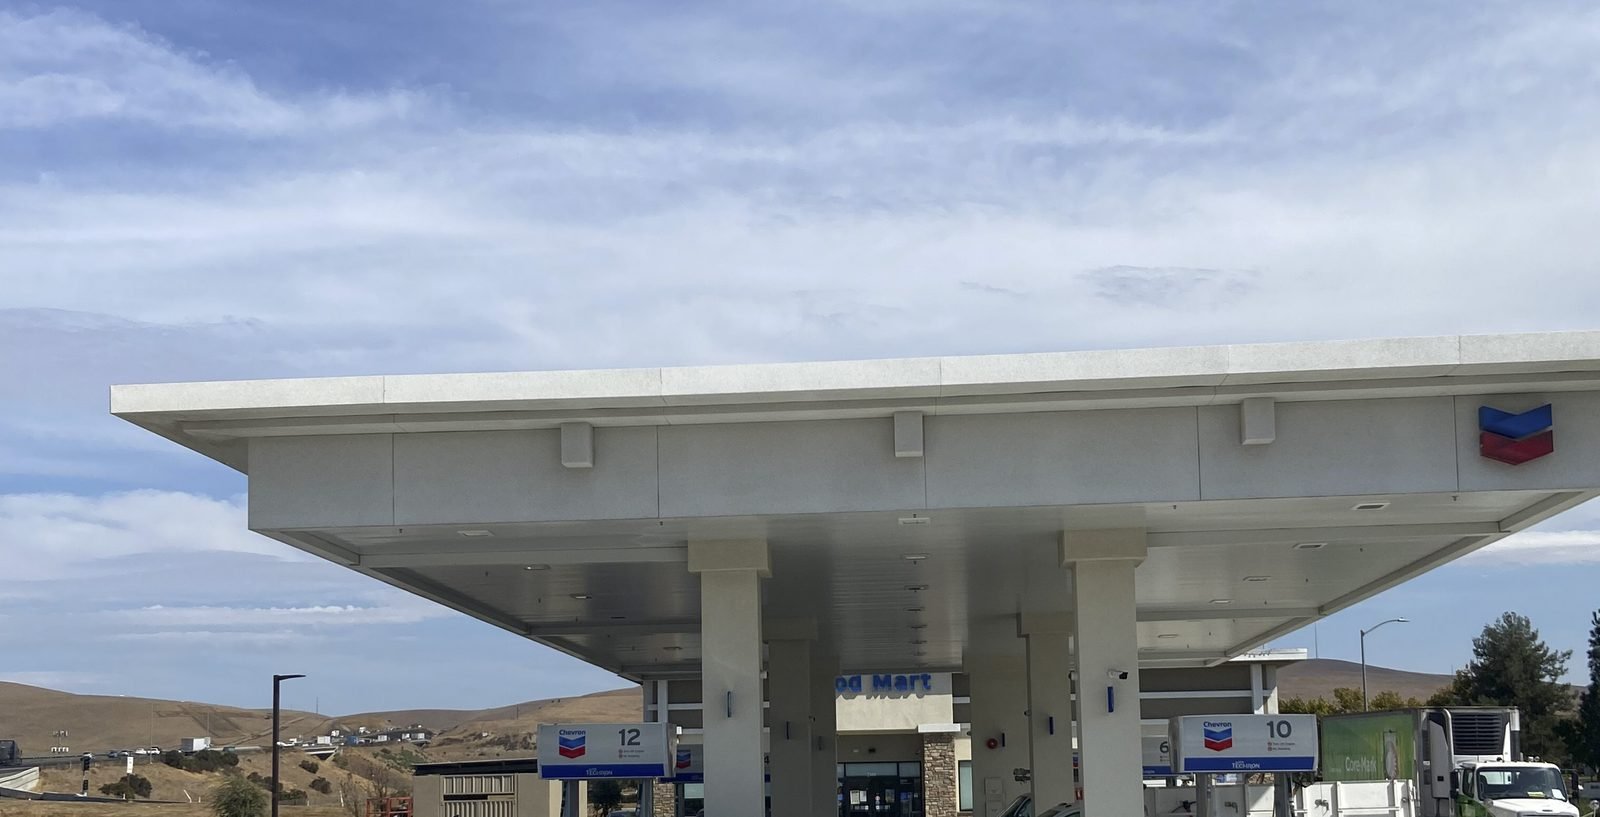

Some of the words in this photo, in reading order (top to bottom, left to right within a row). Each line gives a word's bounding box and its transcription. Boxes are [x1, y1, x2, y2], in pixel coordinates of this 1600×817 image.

[835, 674, 862, 692] od
[872, 673, 931, 691] Mart
[618, 728, 641, 746] 12
[1266, 720, 1292, 738] 10
[1159, 741, 1168, 753] 6
